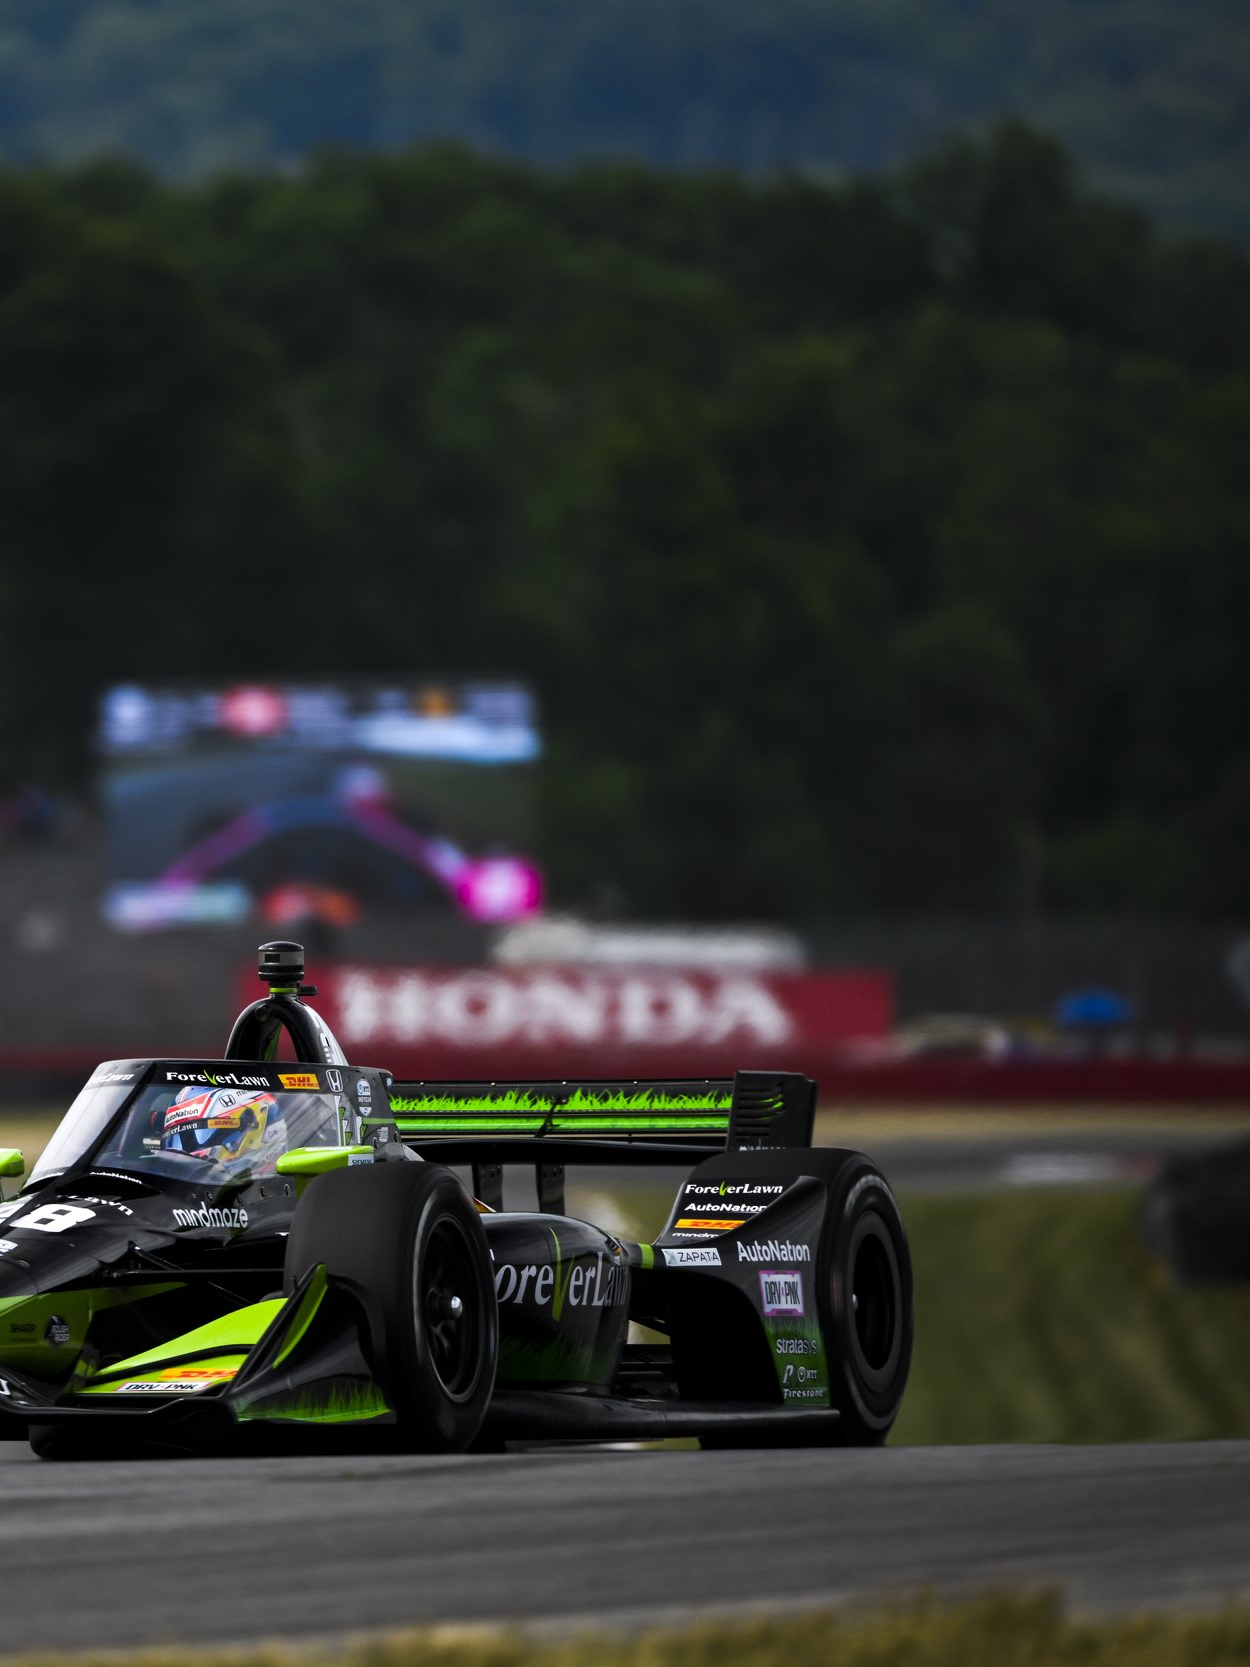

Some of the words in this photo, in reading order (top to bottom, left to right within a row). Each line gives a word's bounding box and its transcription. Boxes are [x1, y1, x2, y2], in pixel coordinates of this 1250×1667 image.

[341, 970, 791, 1046] HONDA
[285, 1076, 316, 1087] DHL
[171, 1201, 249, 1229] mindmaze
[678, 1251, 720, 1262] ZAPATA
[736, 1239, 811, 1262] AutoNation
[764, 1281, 781, 1305] DRV
[784, 1281, 801, 1305] PNK
[125, 1383, 159, 1391] DRV
[165, 1383, 199, 1391] PNK
